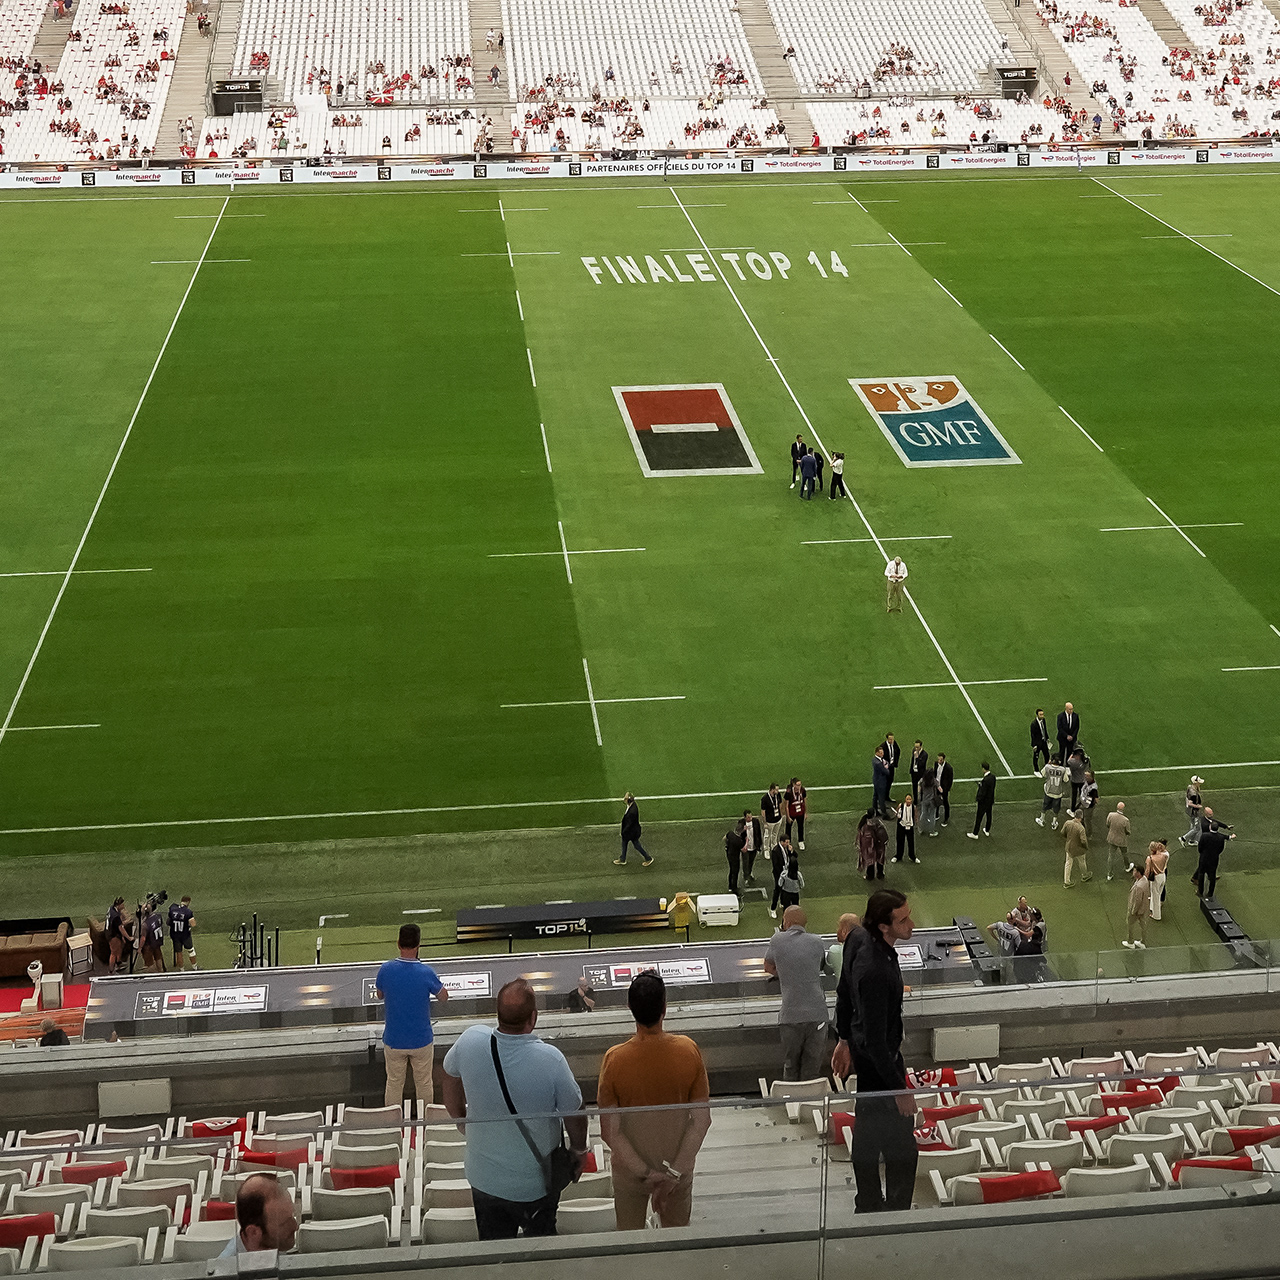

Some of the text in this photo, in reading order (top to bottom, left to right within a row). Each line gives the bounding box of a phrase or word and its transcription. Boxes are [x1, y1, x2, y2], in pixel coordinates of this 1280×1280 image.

[1145, 152, 1185, 160] TotalEnergies
[1233, 151, 1273, 159] TotalEnergies
[586, 164, 651, 172] PARTENAIRES
[653, 163, 689, 171] OFFCIELS
[706, 162, 724, 170] TOP
[726, 162, 736, 170] 14
[873, 158, 915, 166] TotalEnergies
[580, 250, 849, 284] FINALE TOP 14
[899, 420, 981, 447] GMF
[173, 921, 184, 932] TV
[535, 918, 587, 935] TOP14
